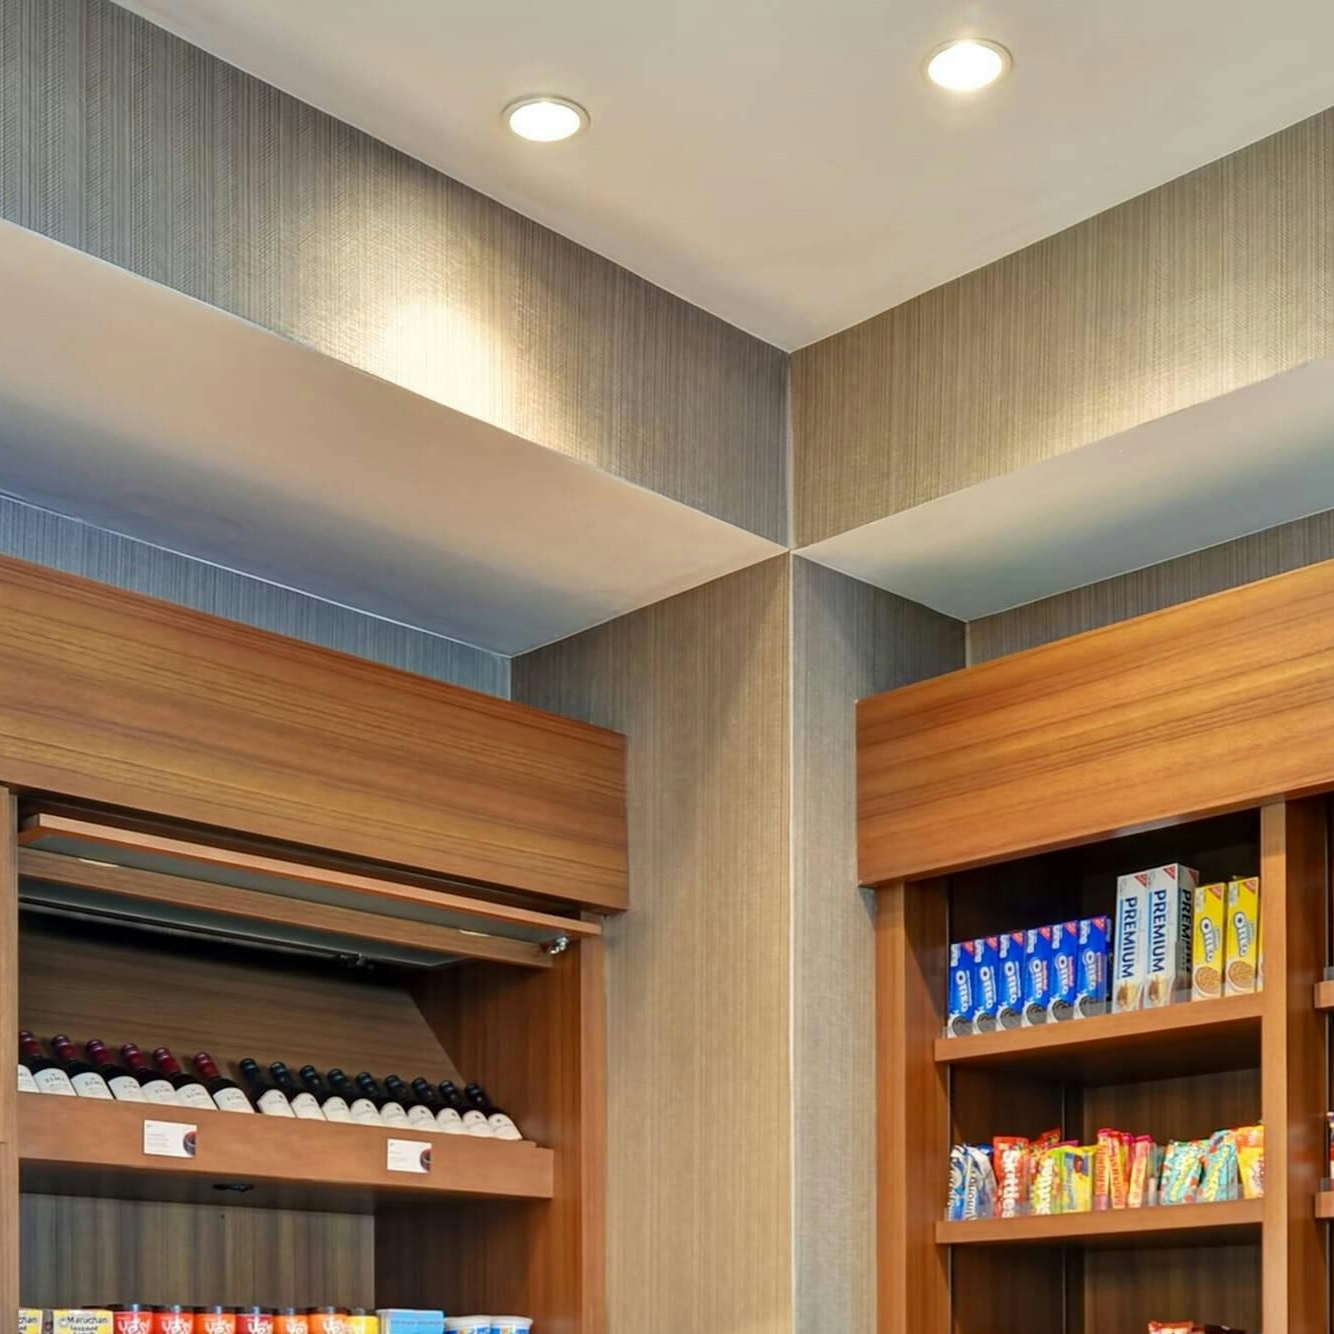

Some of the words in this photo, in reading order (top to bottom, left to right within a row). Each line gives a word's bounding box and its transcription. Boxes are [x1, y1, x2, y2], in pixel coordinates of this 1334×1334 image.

[1121, 896, 1139, 979] PREMIUM
[1151, 888, 1168, 973] PREMIUM
[67, 1316, 108, 1325] Maruchan
